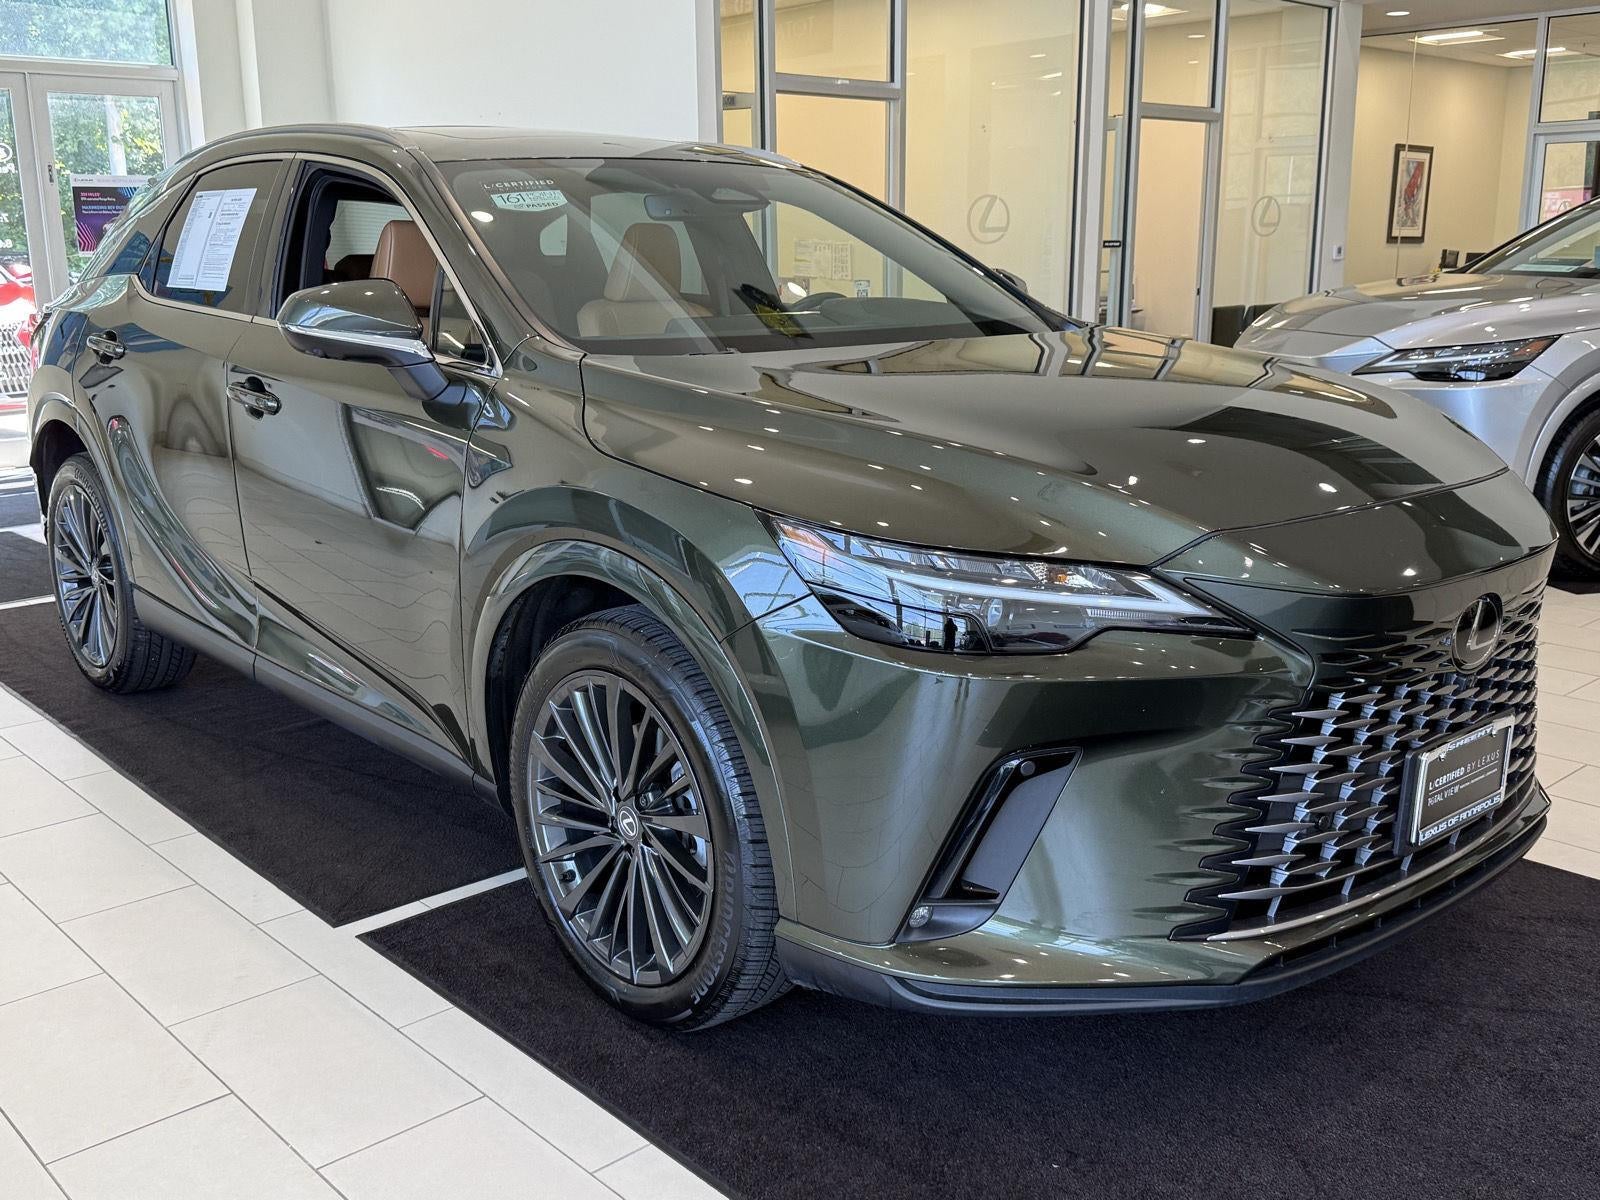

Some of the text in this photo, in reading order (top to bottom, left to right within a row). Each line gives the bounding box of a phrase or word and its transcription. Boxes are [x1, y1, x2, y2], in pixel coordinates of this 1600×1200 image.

[497, 193, 526, 205] 161
[1467, 761, 1476, 773] BY
[1477, 749, 1500, 767] LEXUS
[1444, 784, 1460, 798] VIEW
[1420, 795, 1501, 842] LEXUS OF ANNAPOLIS
